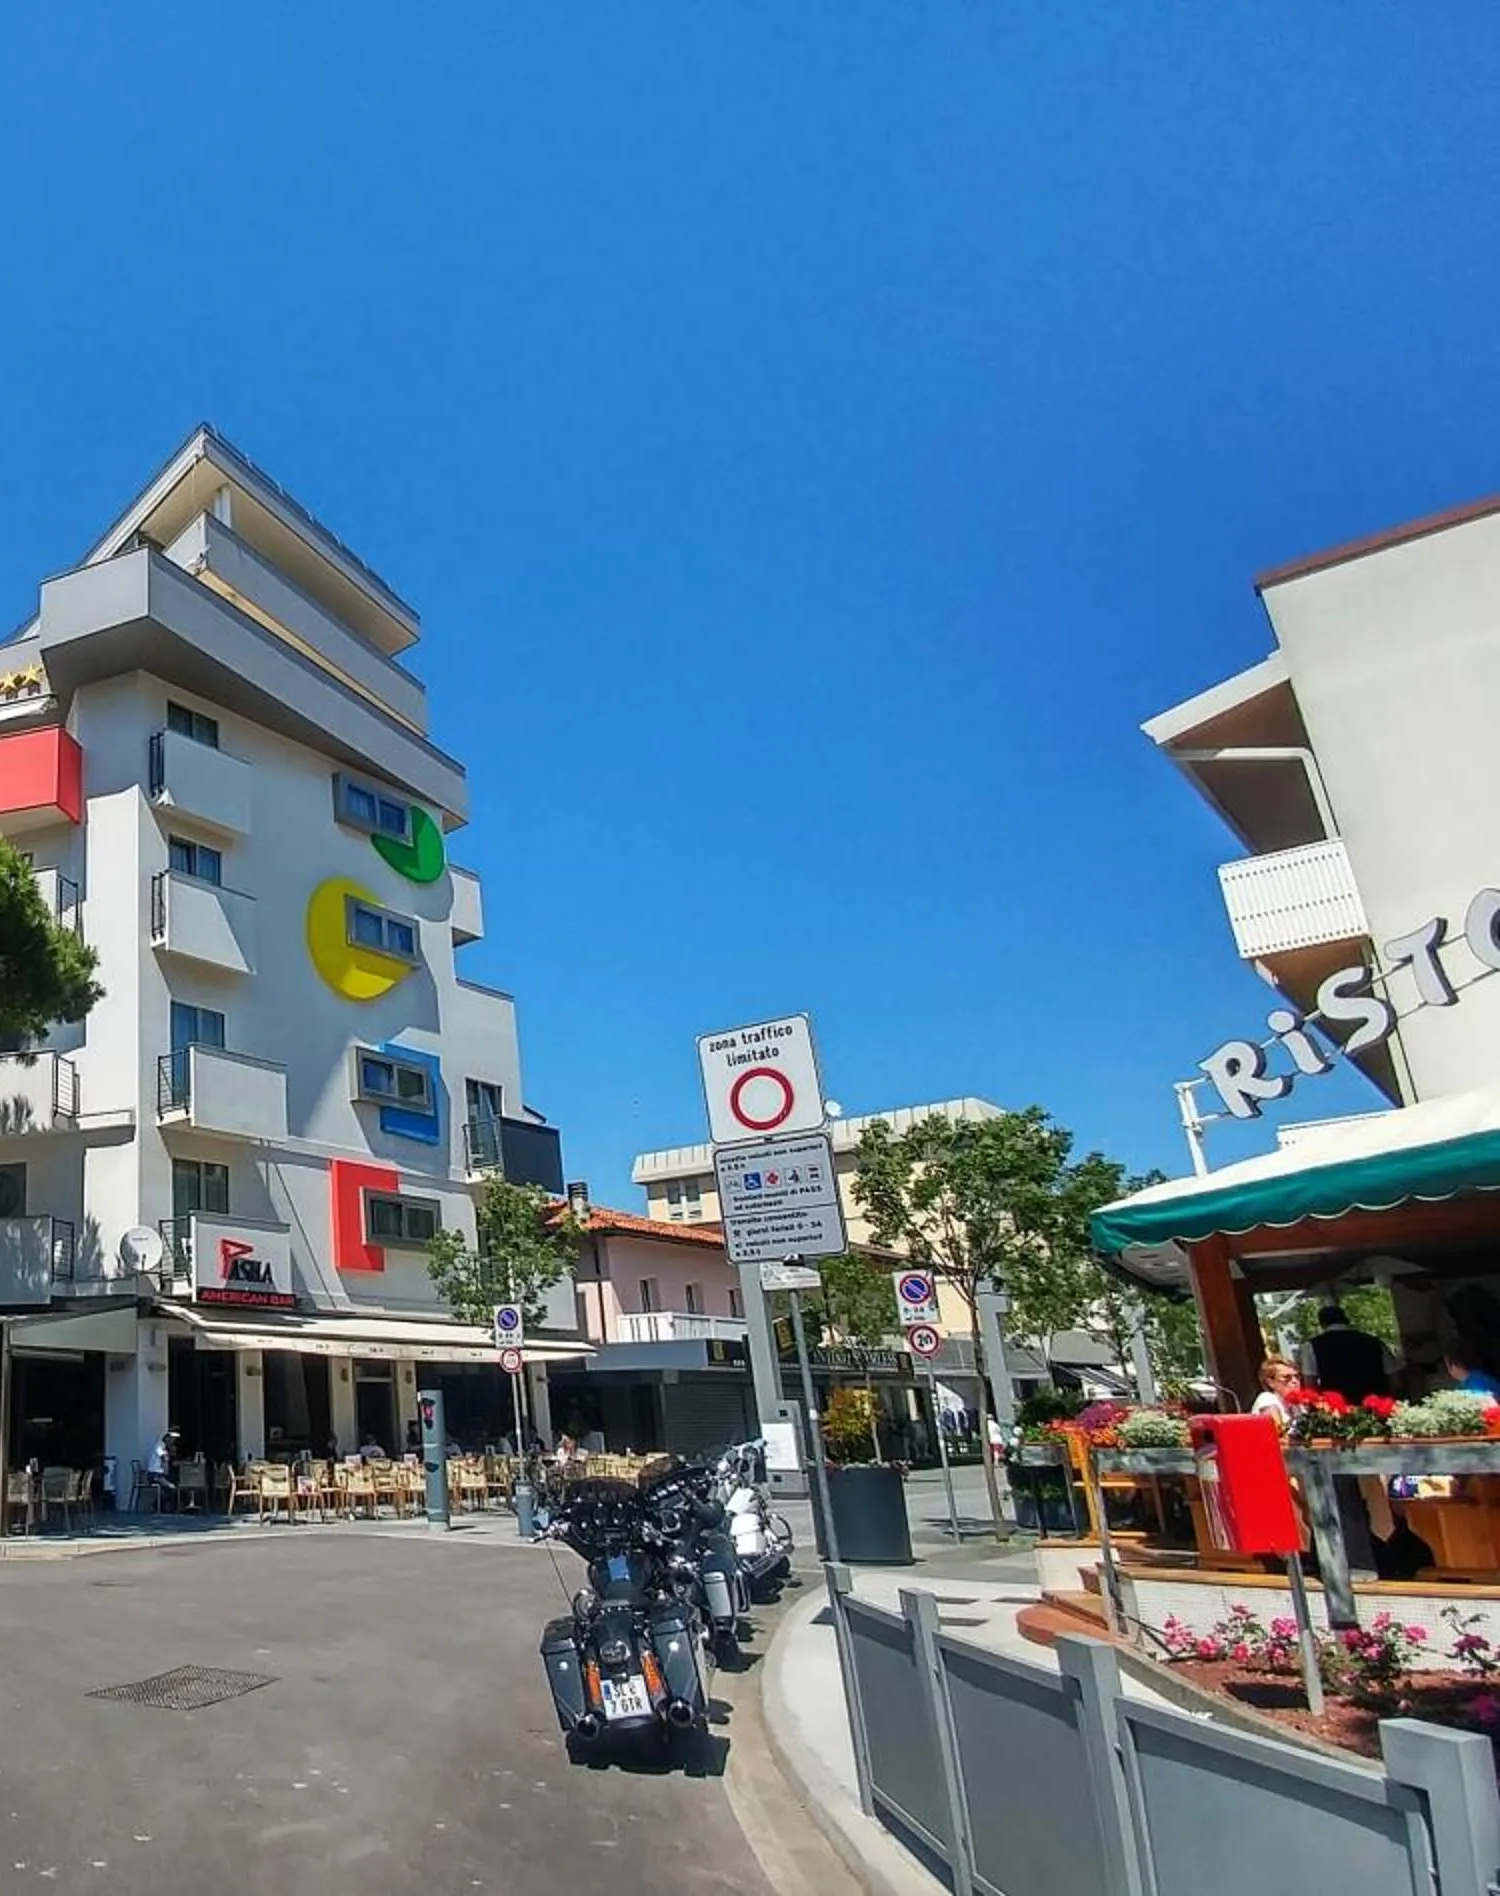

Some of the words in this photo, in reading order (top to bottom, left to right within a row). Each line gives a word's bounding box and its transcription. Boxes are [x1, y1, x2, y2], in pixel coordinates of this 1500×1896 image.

[709, 1038, 737, 1053] zona
[741, 1024, 793, 1045] traffico
[726, 1045, 780, 1067] limitato
[201, 1289, 269, 1303] AMERICAN
[270, 1294, 295, 1305] BAR
